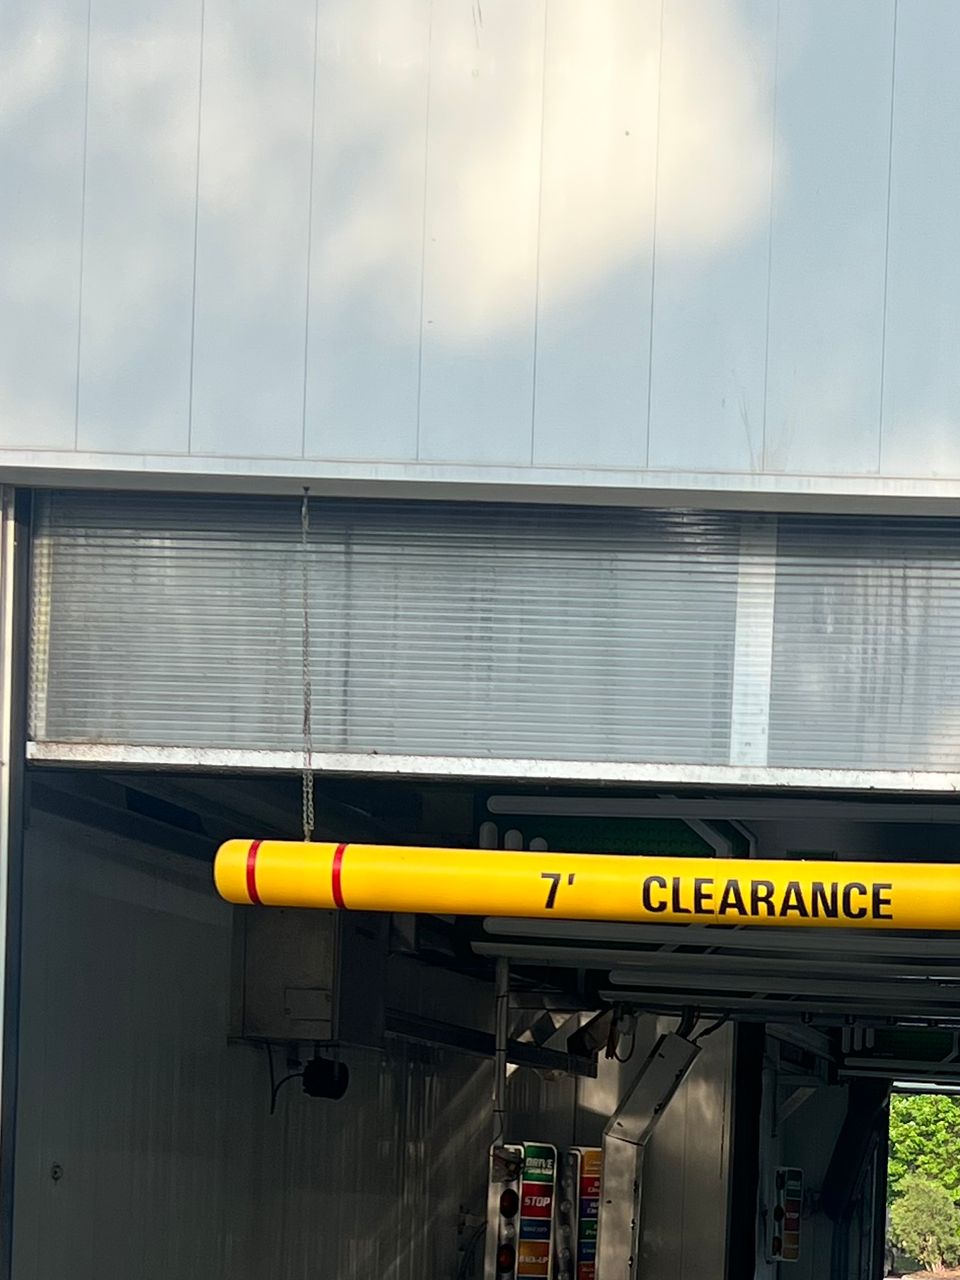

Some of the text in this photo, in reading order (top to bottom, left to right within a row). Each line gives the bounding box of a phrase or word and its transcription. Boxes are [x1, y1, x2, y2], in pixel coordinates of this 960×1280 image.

[541, 873, 893, 920] 7' CLEARANCE
[523, 1196, 550, 1207] STOP
